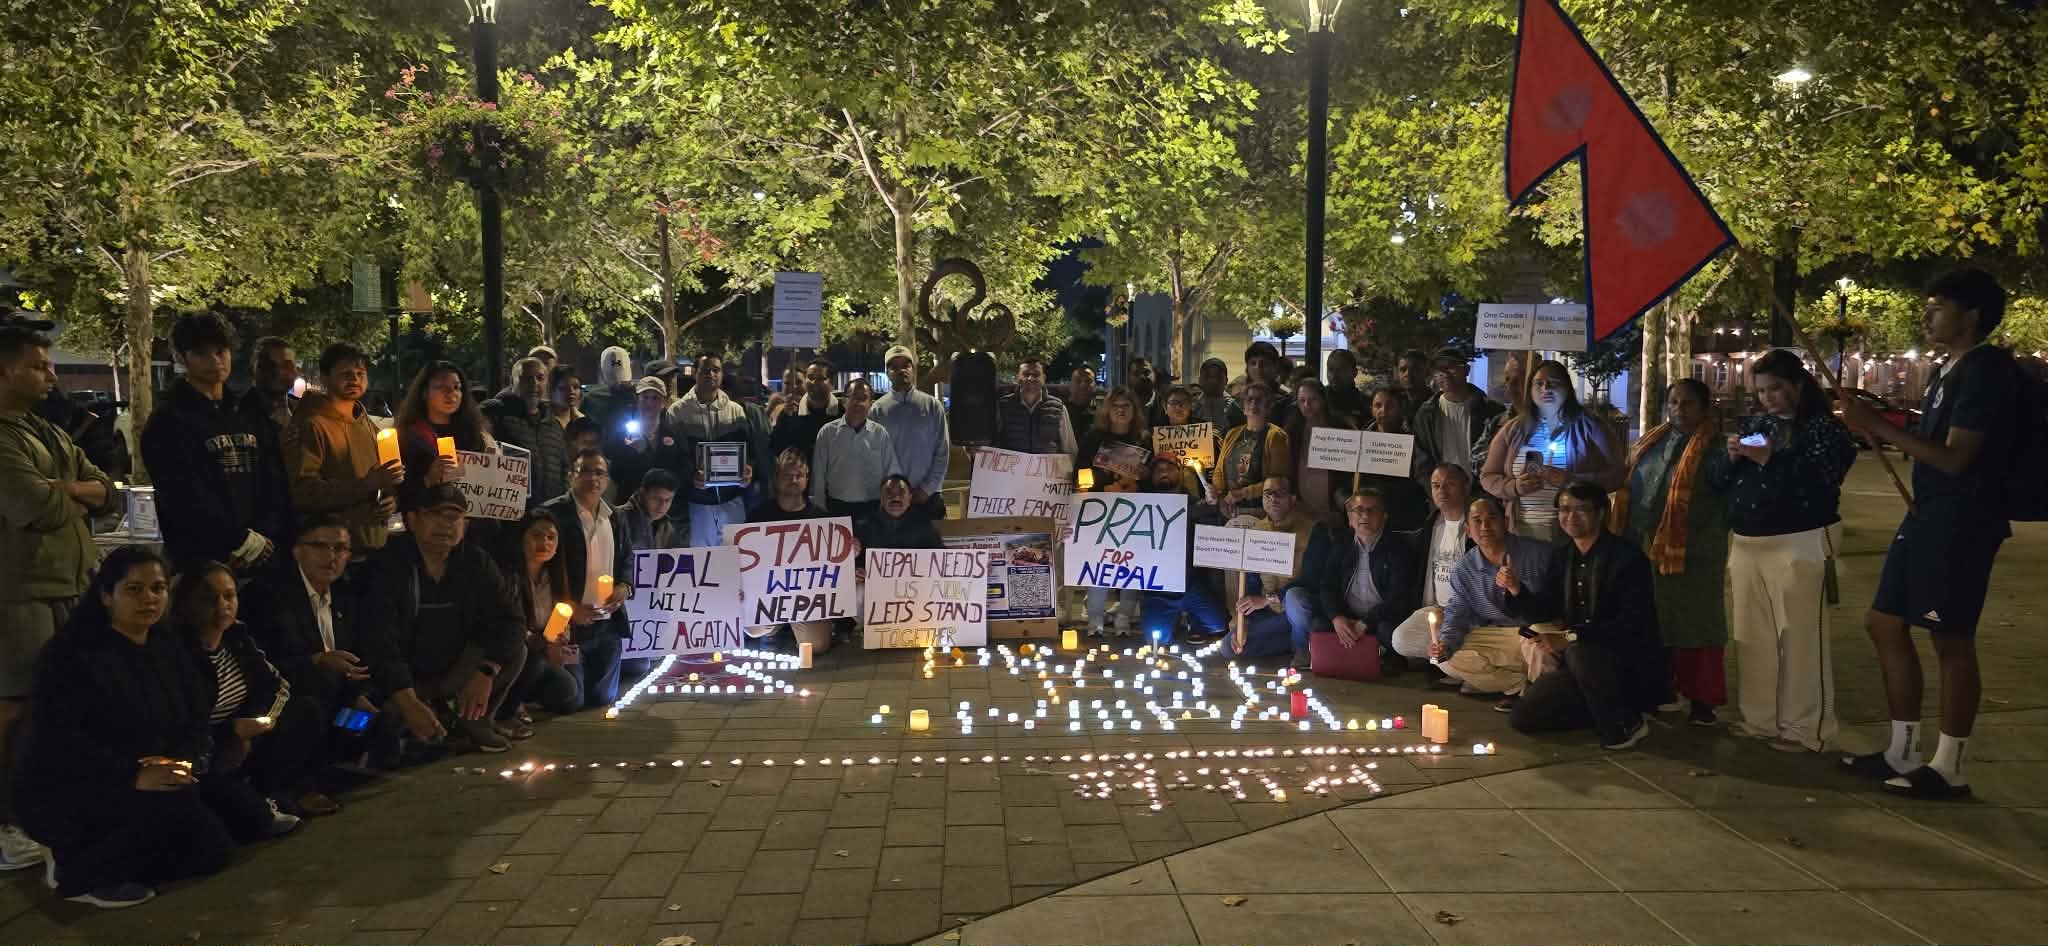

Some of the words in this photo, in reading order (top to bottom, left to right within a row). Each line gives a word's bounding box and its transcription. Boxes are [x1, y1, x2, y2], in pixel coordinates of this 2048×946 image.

[497, 455, 528, 474] WITH
[453, 482, 484, 496] TAND
[487, 485, 519, 502] WITH
[1073, 496, 1186, 551] PRAY
[733, 520, 853, 573] STAND
[1100, 548, 1135, 566] FOR
[632, 551, 719, 589] EPAL
[766, 564, 841, 594] WITH
[868, 550, 924, 579] NEPAL
[928, 551, 986, 578] NEEDS
[1077, 560, 1164, 590] NEPAL
[649, 591, 705, 614] WILL
[893, 580, 922, 599] US
[929, 580, 973, 601] NOW
[754, 592, 844, 625] NEPAL
[867, 600, 915, 625] LETS
[919, 601, 983, 623] STAND
[625, 619, 668, 652] ISE
[672, 617, 741, 650] AGAIN
[873, 626, 957, 648] TOGETHER
